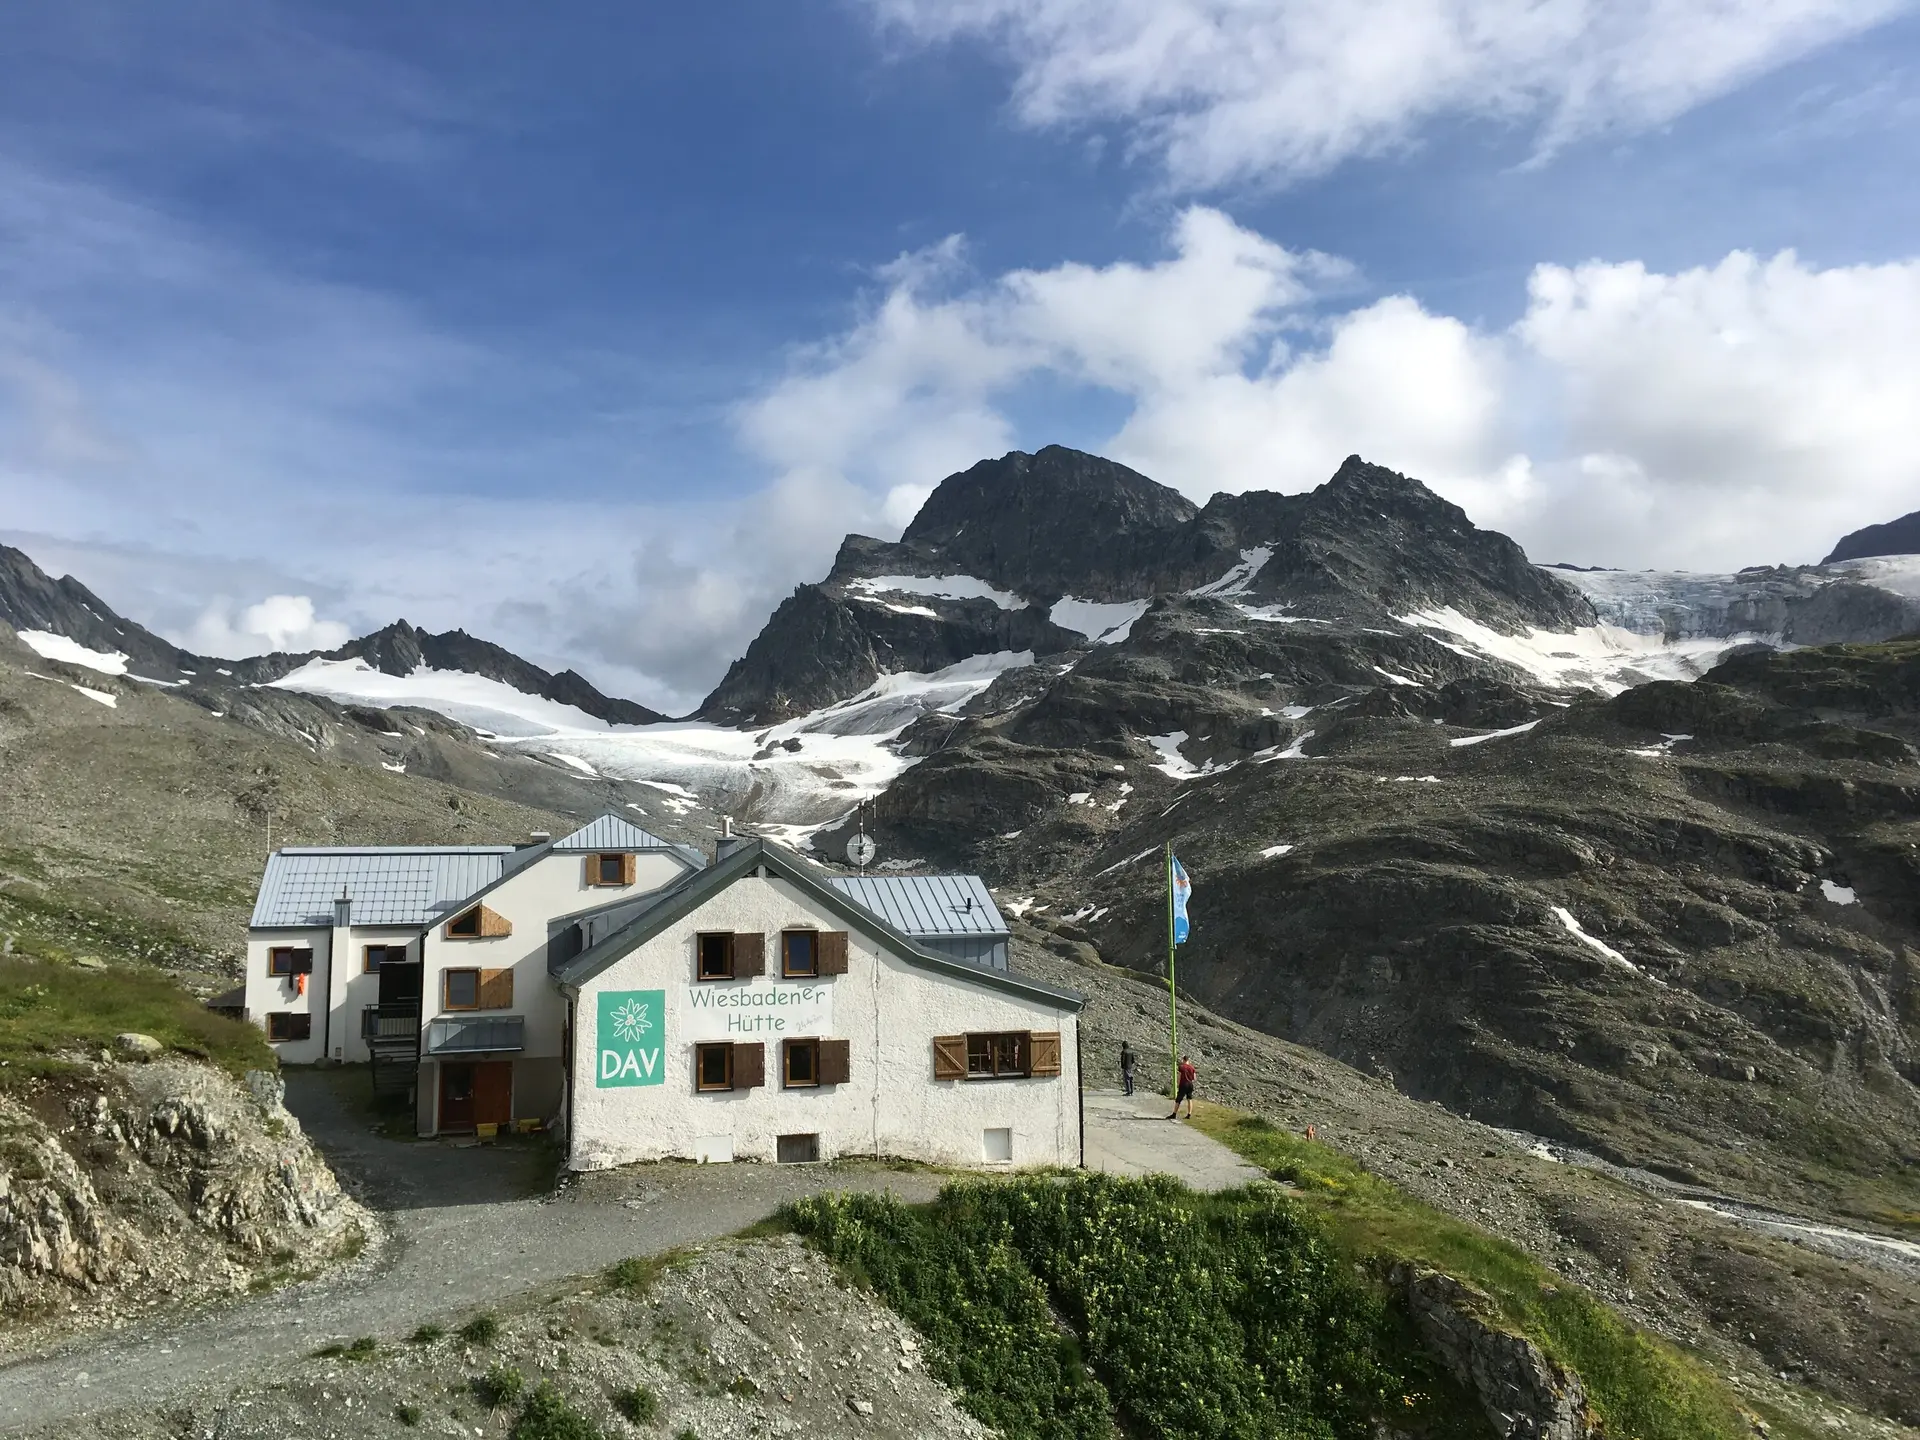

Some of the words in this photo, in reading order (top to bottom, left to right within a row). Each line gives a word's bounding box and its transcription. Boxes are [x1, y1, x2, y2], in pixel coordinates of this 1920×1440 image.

[689, 986, 826, 1008] Wiesbadener
[728, 1013, 786, 1032] Hütte
[601, 1047, 660, 1080] DAV
